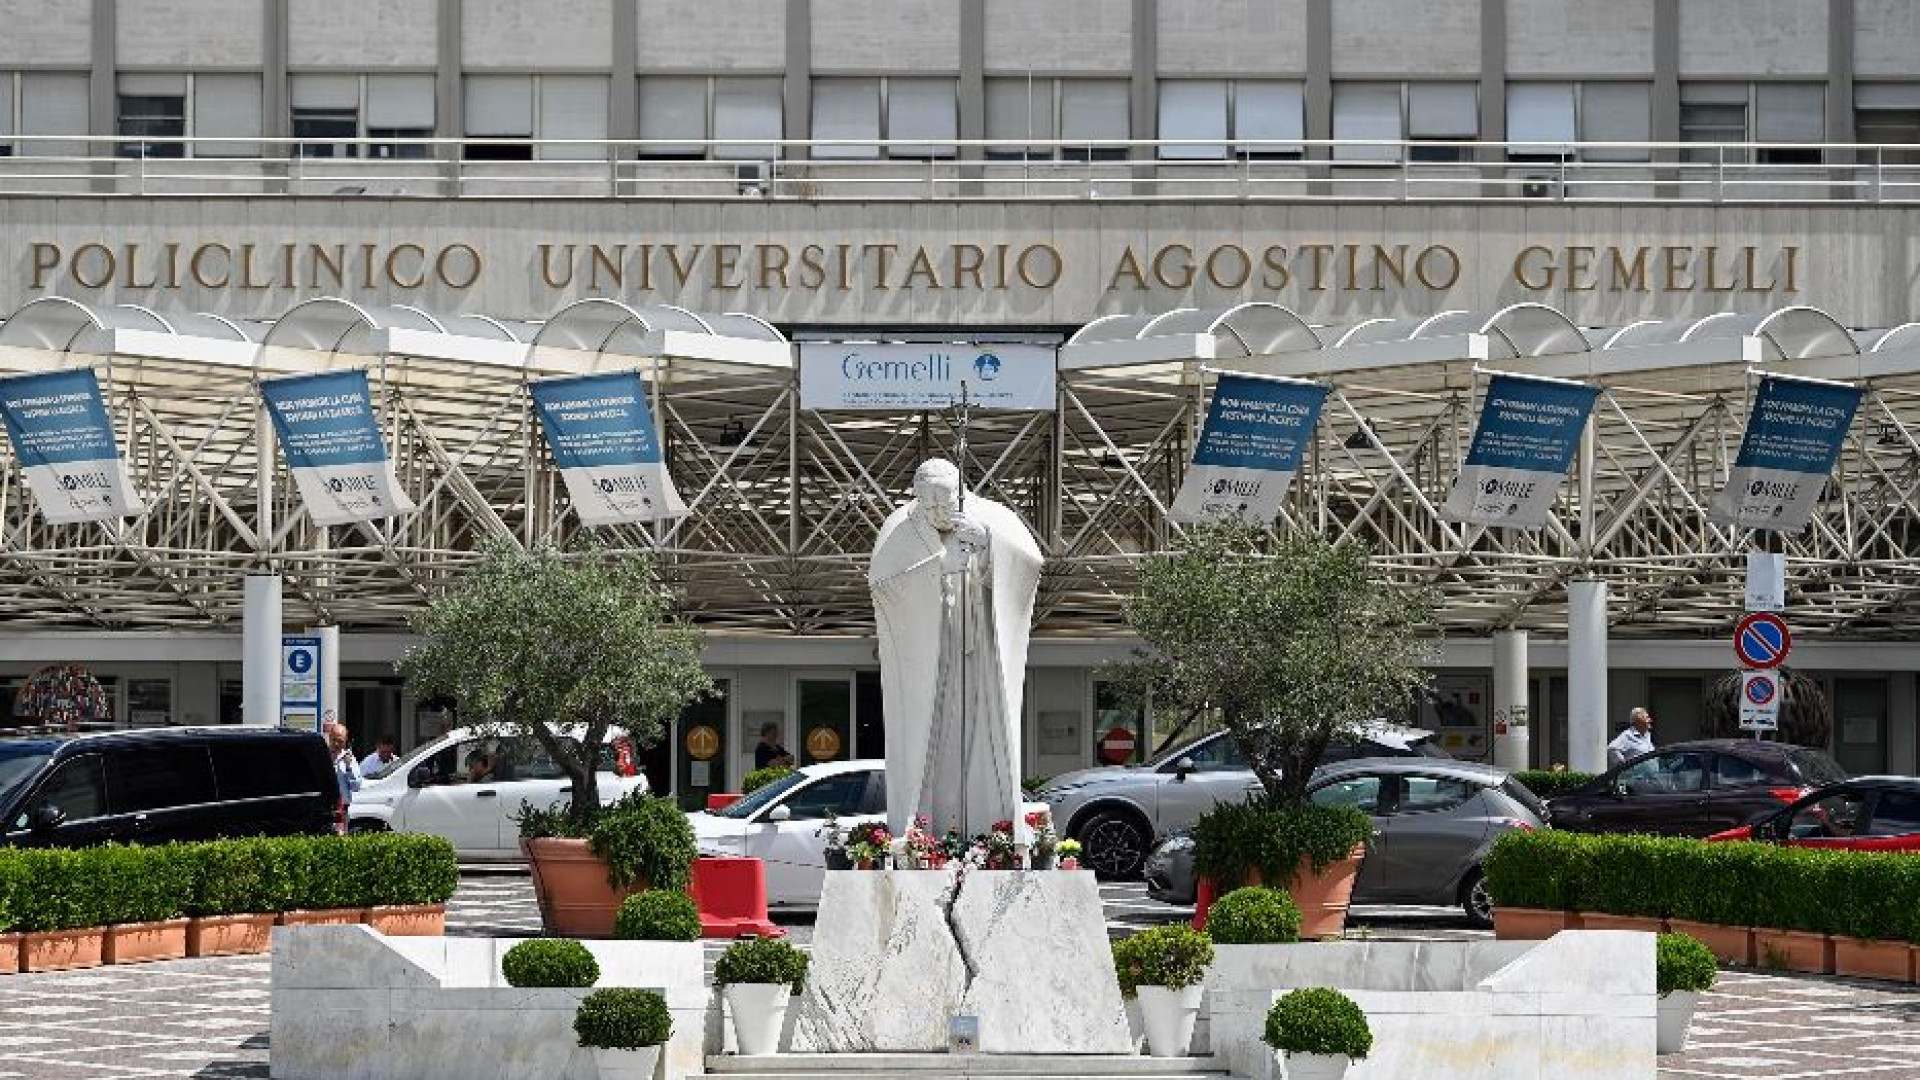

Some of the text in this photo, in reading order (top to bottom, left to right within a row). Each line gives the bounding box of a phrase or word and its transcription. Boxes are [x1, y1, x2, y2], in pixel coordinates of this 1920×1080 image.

[30, 243, 1802, 293] POLICLINICO UNIVERSITARIO AGOSTINO GEMELLI
[842, 353, 951, 382] Gemelli
[296, 654, 305, 668] E
